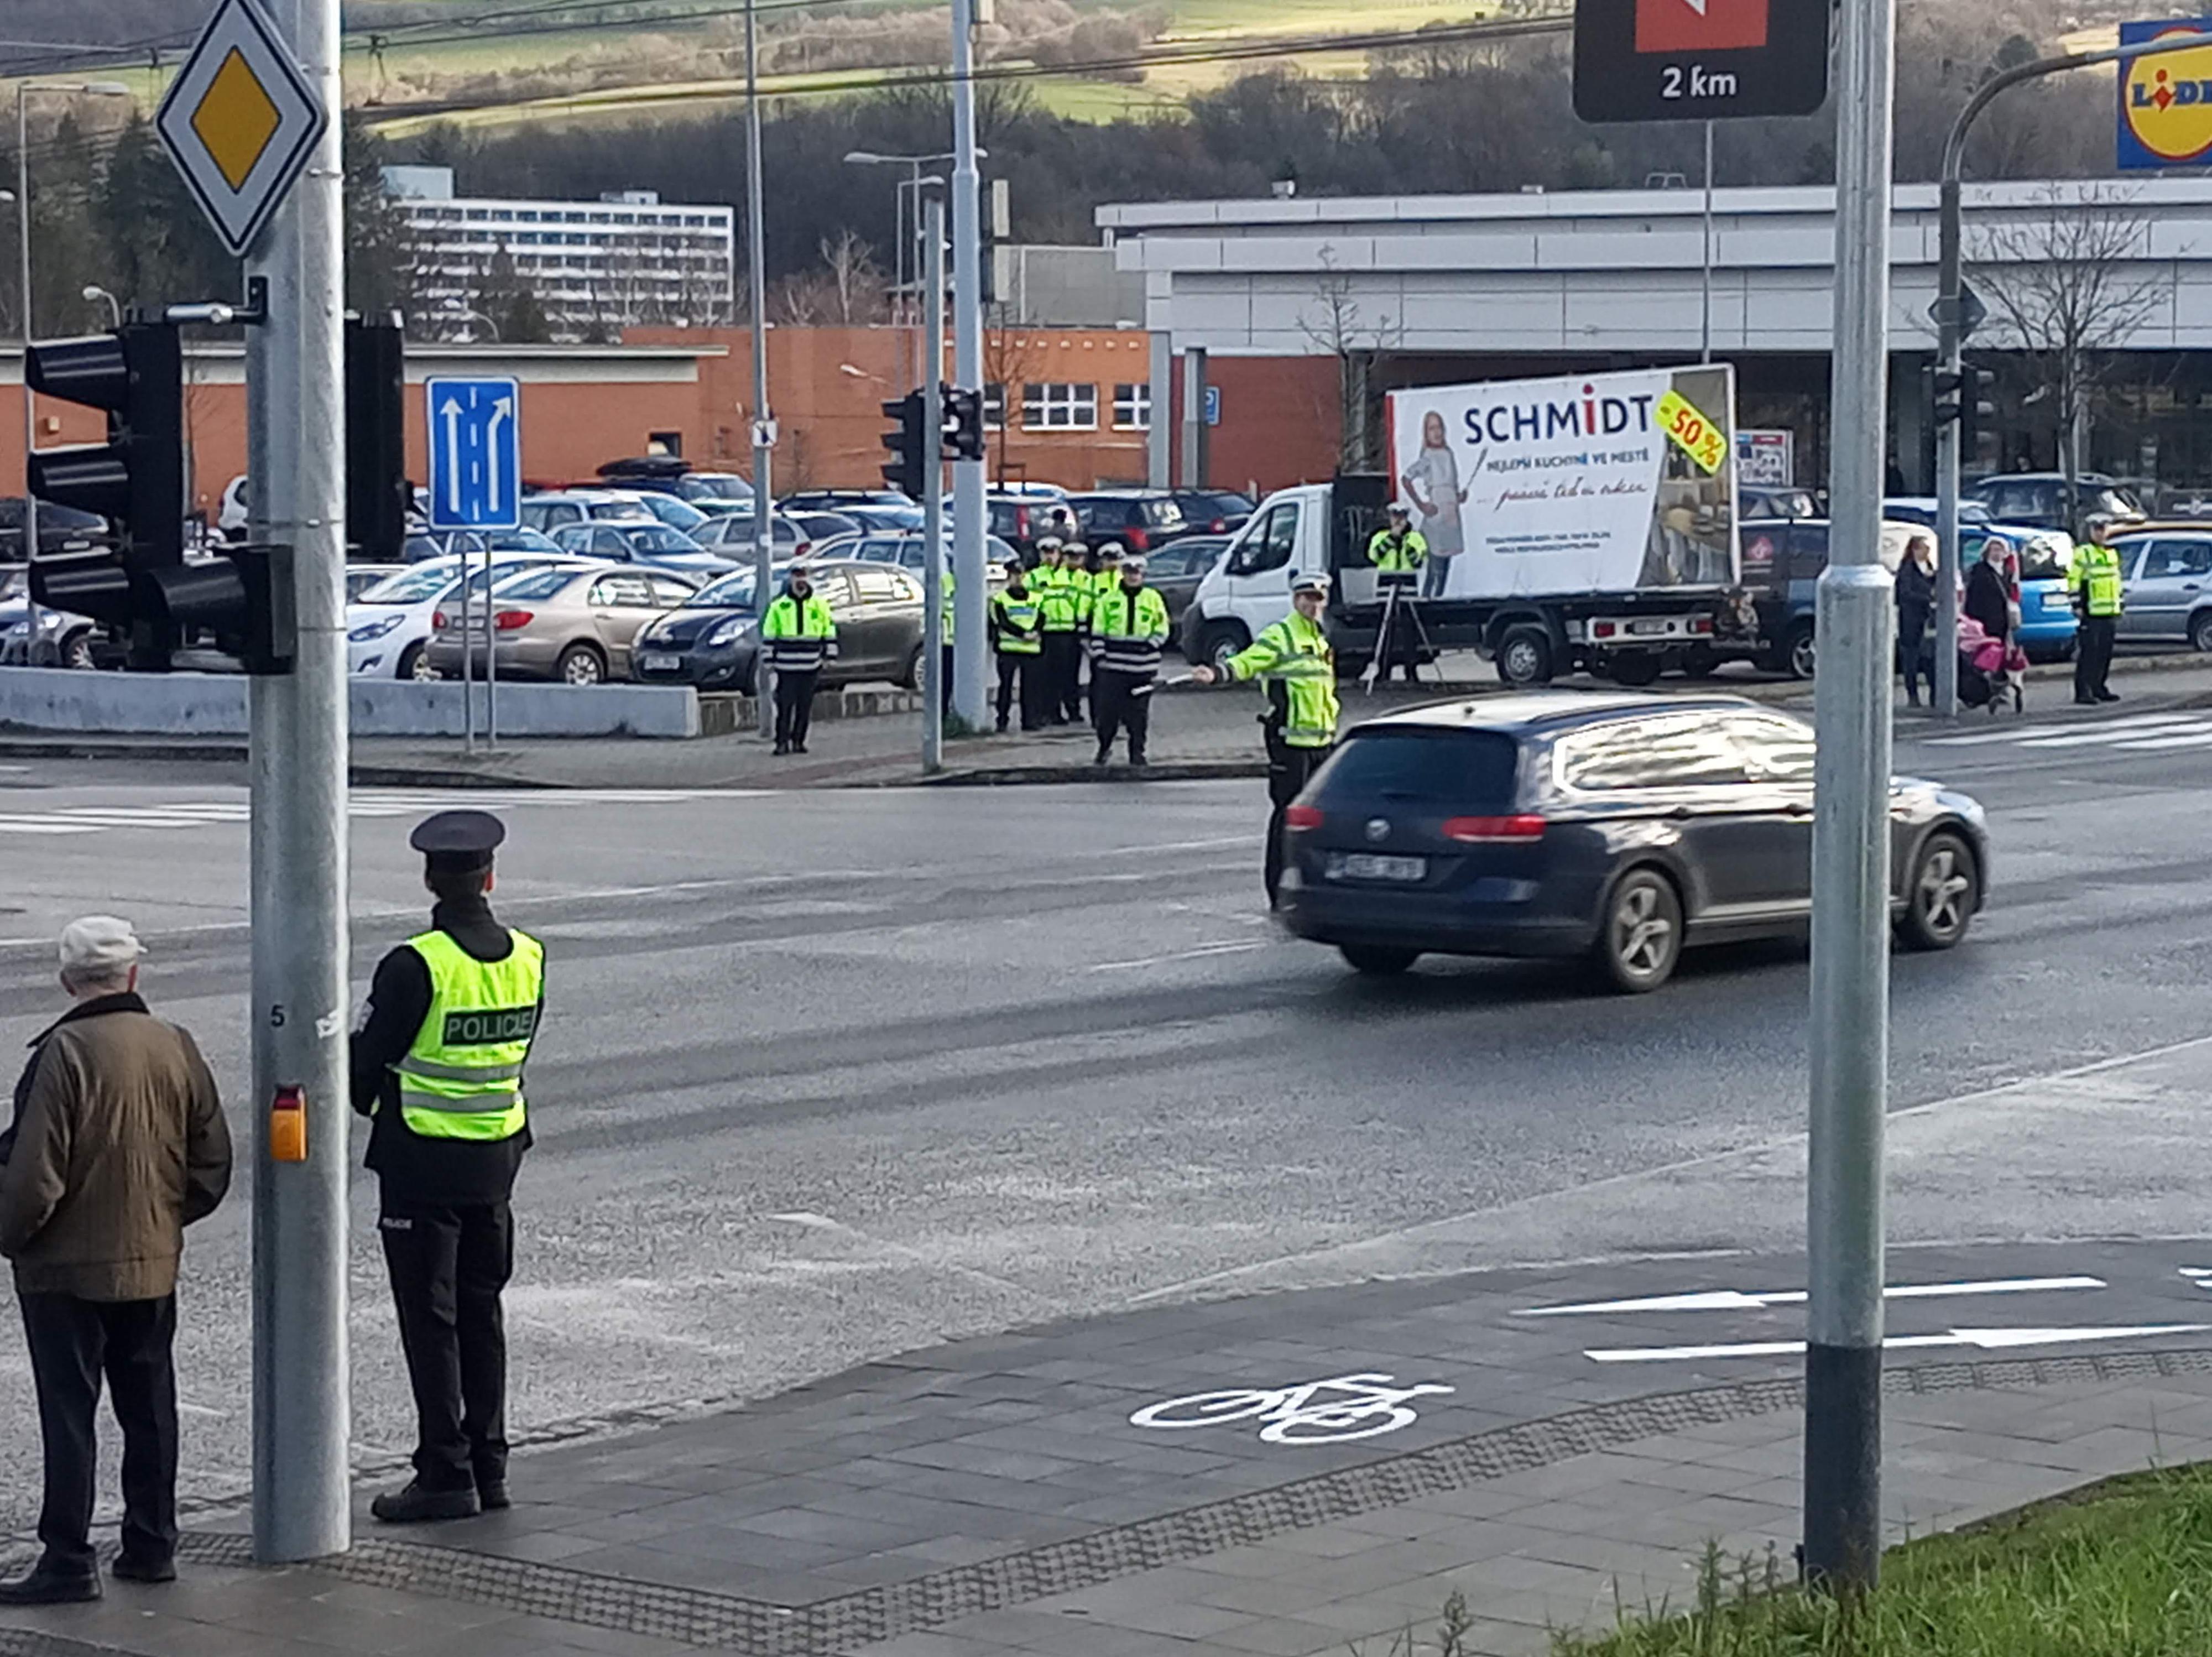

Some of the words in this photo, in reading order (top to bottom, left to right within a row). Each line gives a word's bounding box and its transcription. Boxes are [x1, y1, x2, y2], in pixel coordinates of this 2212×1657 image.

[1662, 66, 1682, 98] 2
[1690, 65, 1737, 97] km
[271, 1004, 285, 1027] 5
